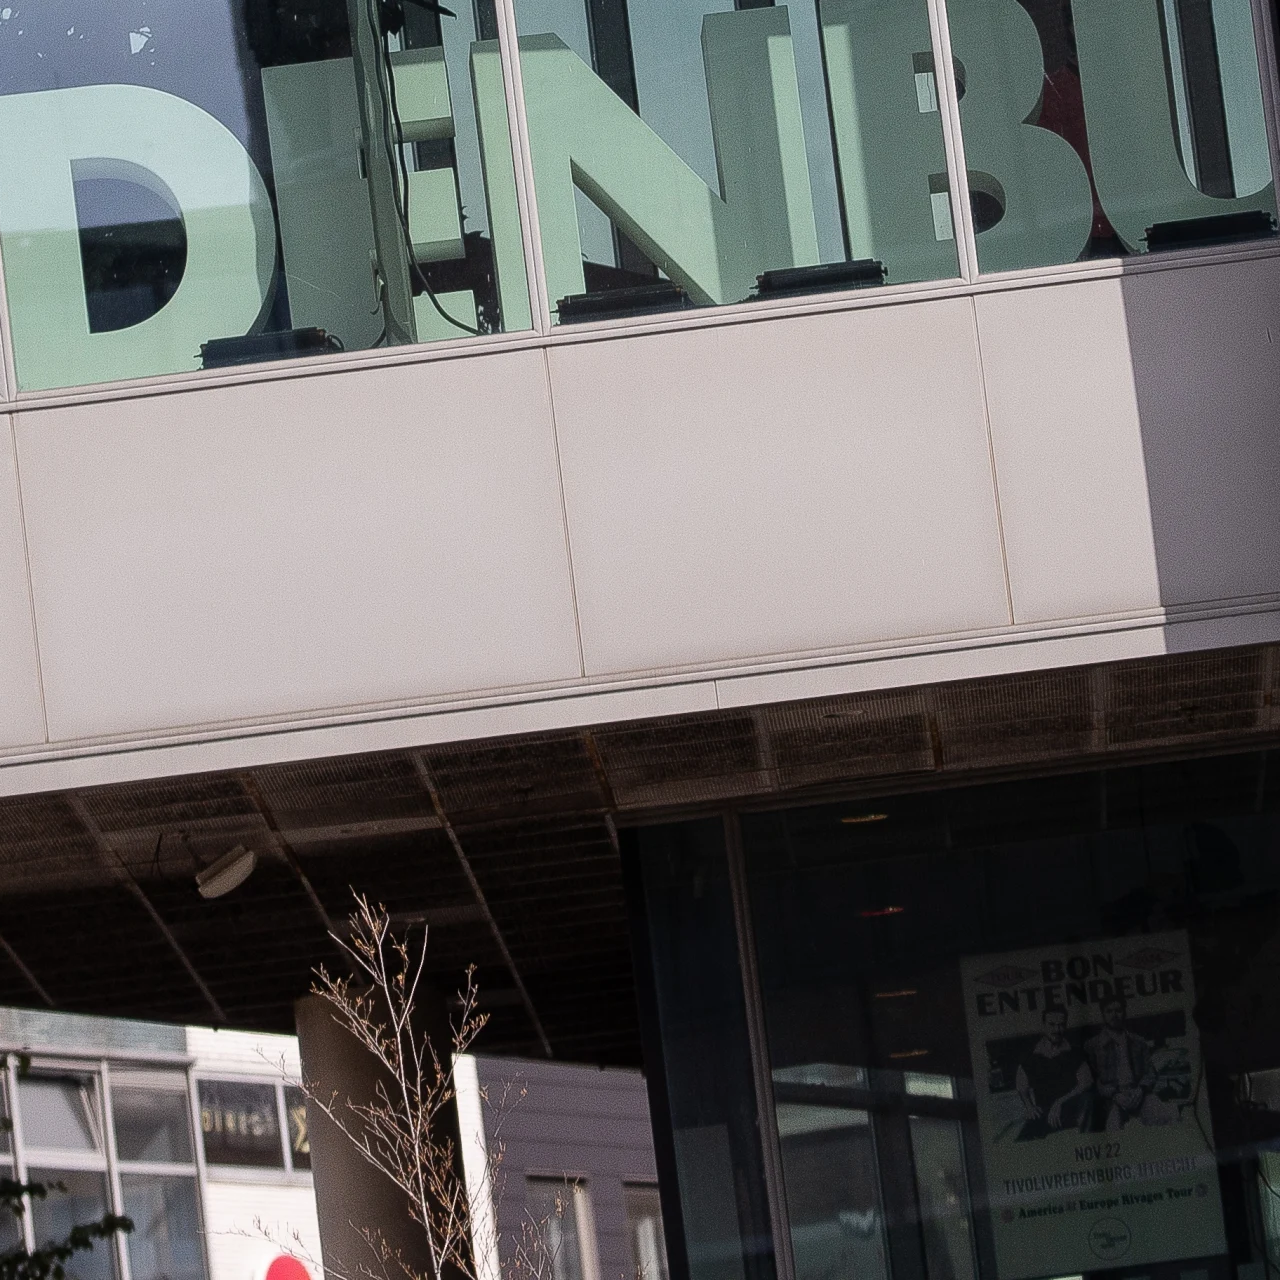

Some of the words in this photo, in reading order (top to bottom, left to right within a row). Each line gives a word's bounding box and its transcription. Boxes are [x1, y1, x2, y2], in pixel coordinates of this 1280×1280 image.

[1040, 952, 1115, 984] BON
[976, 969, 1185, 1017] ENTENDEUR
[1074, 1146, 1101, 1163] NOV
[1106, 1142, 1121, 1159] 22
[1018, 1204, 1064, 1220] America
[1079, 1197, 1120, 1212] Europe
[1166, 1186, 1193, 1200] Tour
